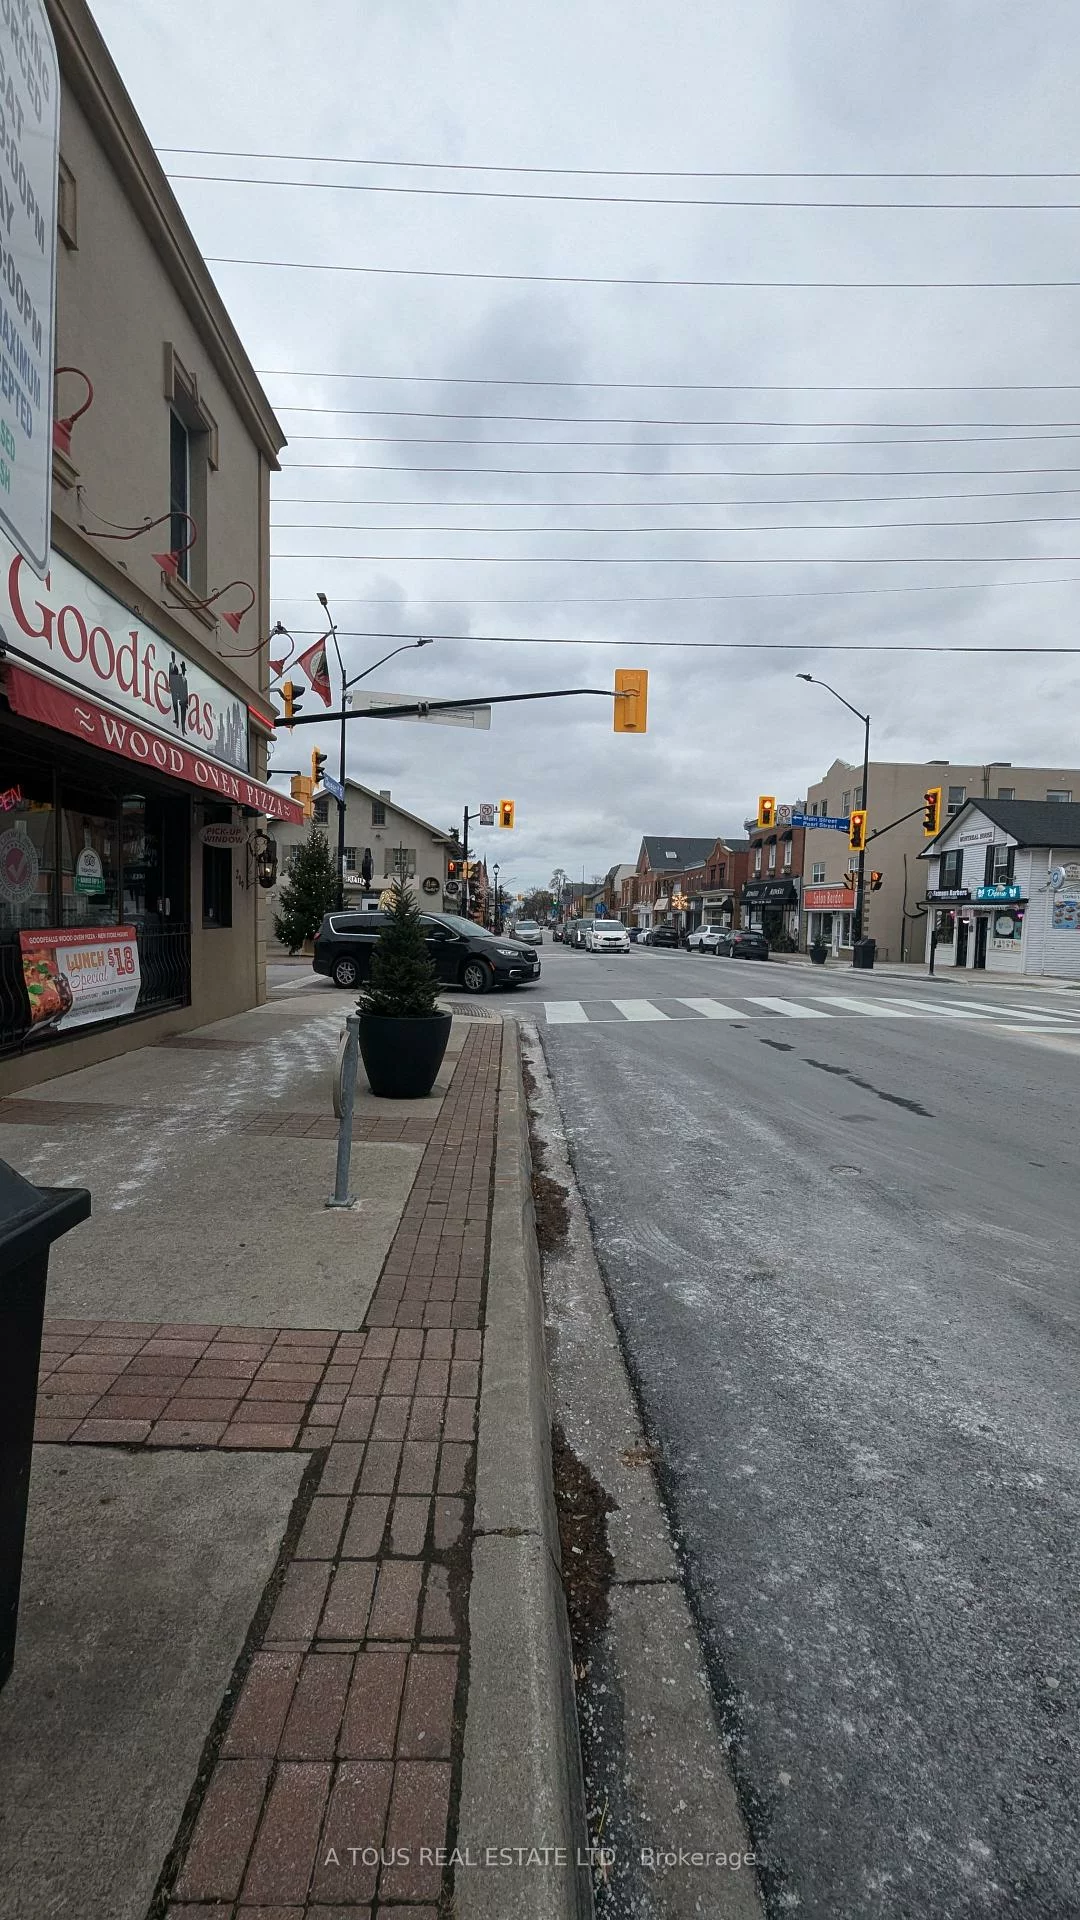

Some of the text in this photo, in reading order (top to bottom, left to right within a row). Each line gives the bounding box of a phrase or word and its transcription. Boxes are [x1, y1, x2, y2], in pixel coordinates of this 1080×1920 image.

[99, 713, 284, 817] WOOD OVEN PIZZA
[203, 835, 244, 844] WINDOW
[206, 827, 242, 836] PICK-UP
[59, 935, 73, 943] WOOD
[65, 945, 135, 976] LUNCH $18
[70, 966, 109, 993] Special
